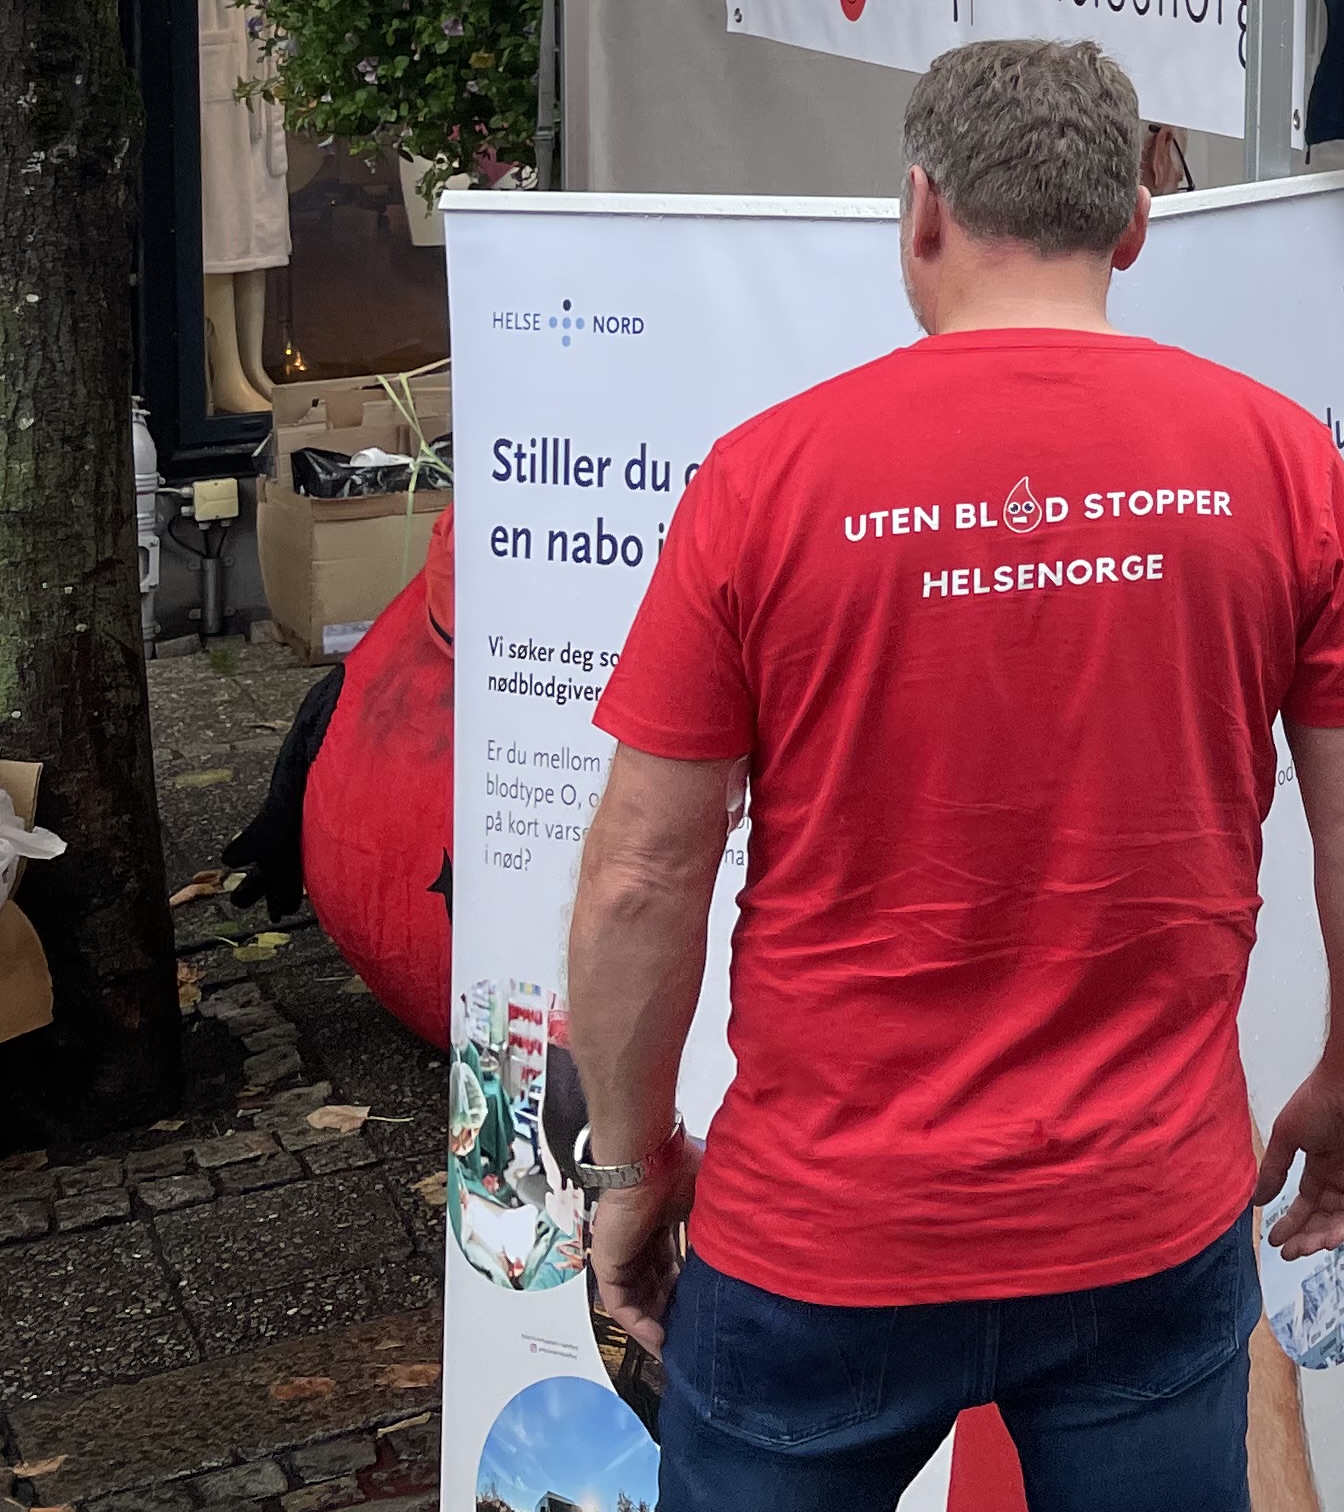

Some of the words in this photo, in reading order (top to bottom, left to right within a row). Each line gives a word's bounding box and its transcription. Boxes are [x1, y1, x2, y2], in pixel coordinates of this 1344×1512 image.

[492, 312, 541, 331] HELSE
[593, 316, 644, 334] NORD
[492, 437, 612, 488] Stilller
[625, 443, 670, 491] du
[844, 504, 939, 543] UTEN
[1084, 490, 1233, 520] STOPPER
[491, 525, 531, 559] en
[548, 517, 643, 567] nabo
[923, 554, 1164, 598] HELSENORGE
[489, 635, 504, 657] Vi
[508, 638, 554, 663] søker
[560, 641, 593, 672] deg
[599, 651, 620, 668] so
[488, 672, 602, 705] nødblodgiver
[487, 740, 502, 761] Er
[507, 740, 526, 765] du
[534, 745, 600, 772] mellom
[486, 773, 554, 809] blodtype
[561, 784, 581, 810] O,
[486, 811, 502, 836] på
[508, 817, 539, 837] kort
[485, 844, 489, 864] i
[493, 848, 532, 871] nød?
